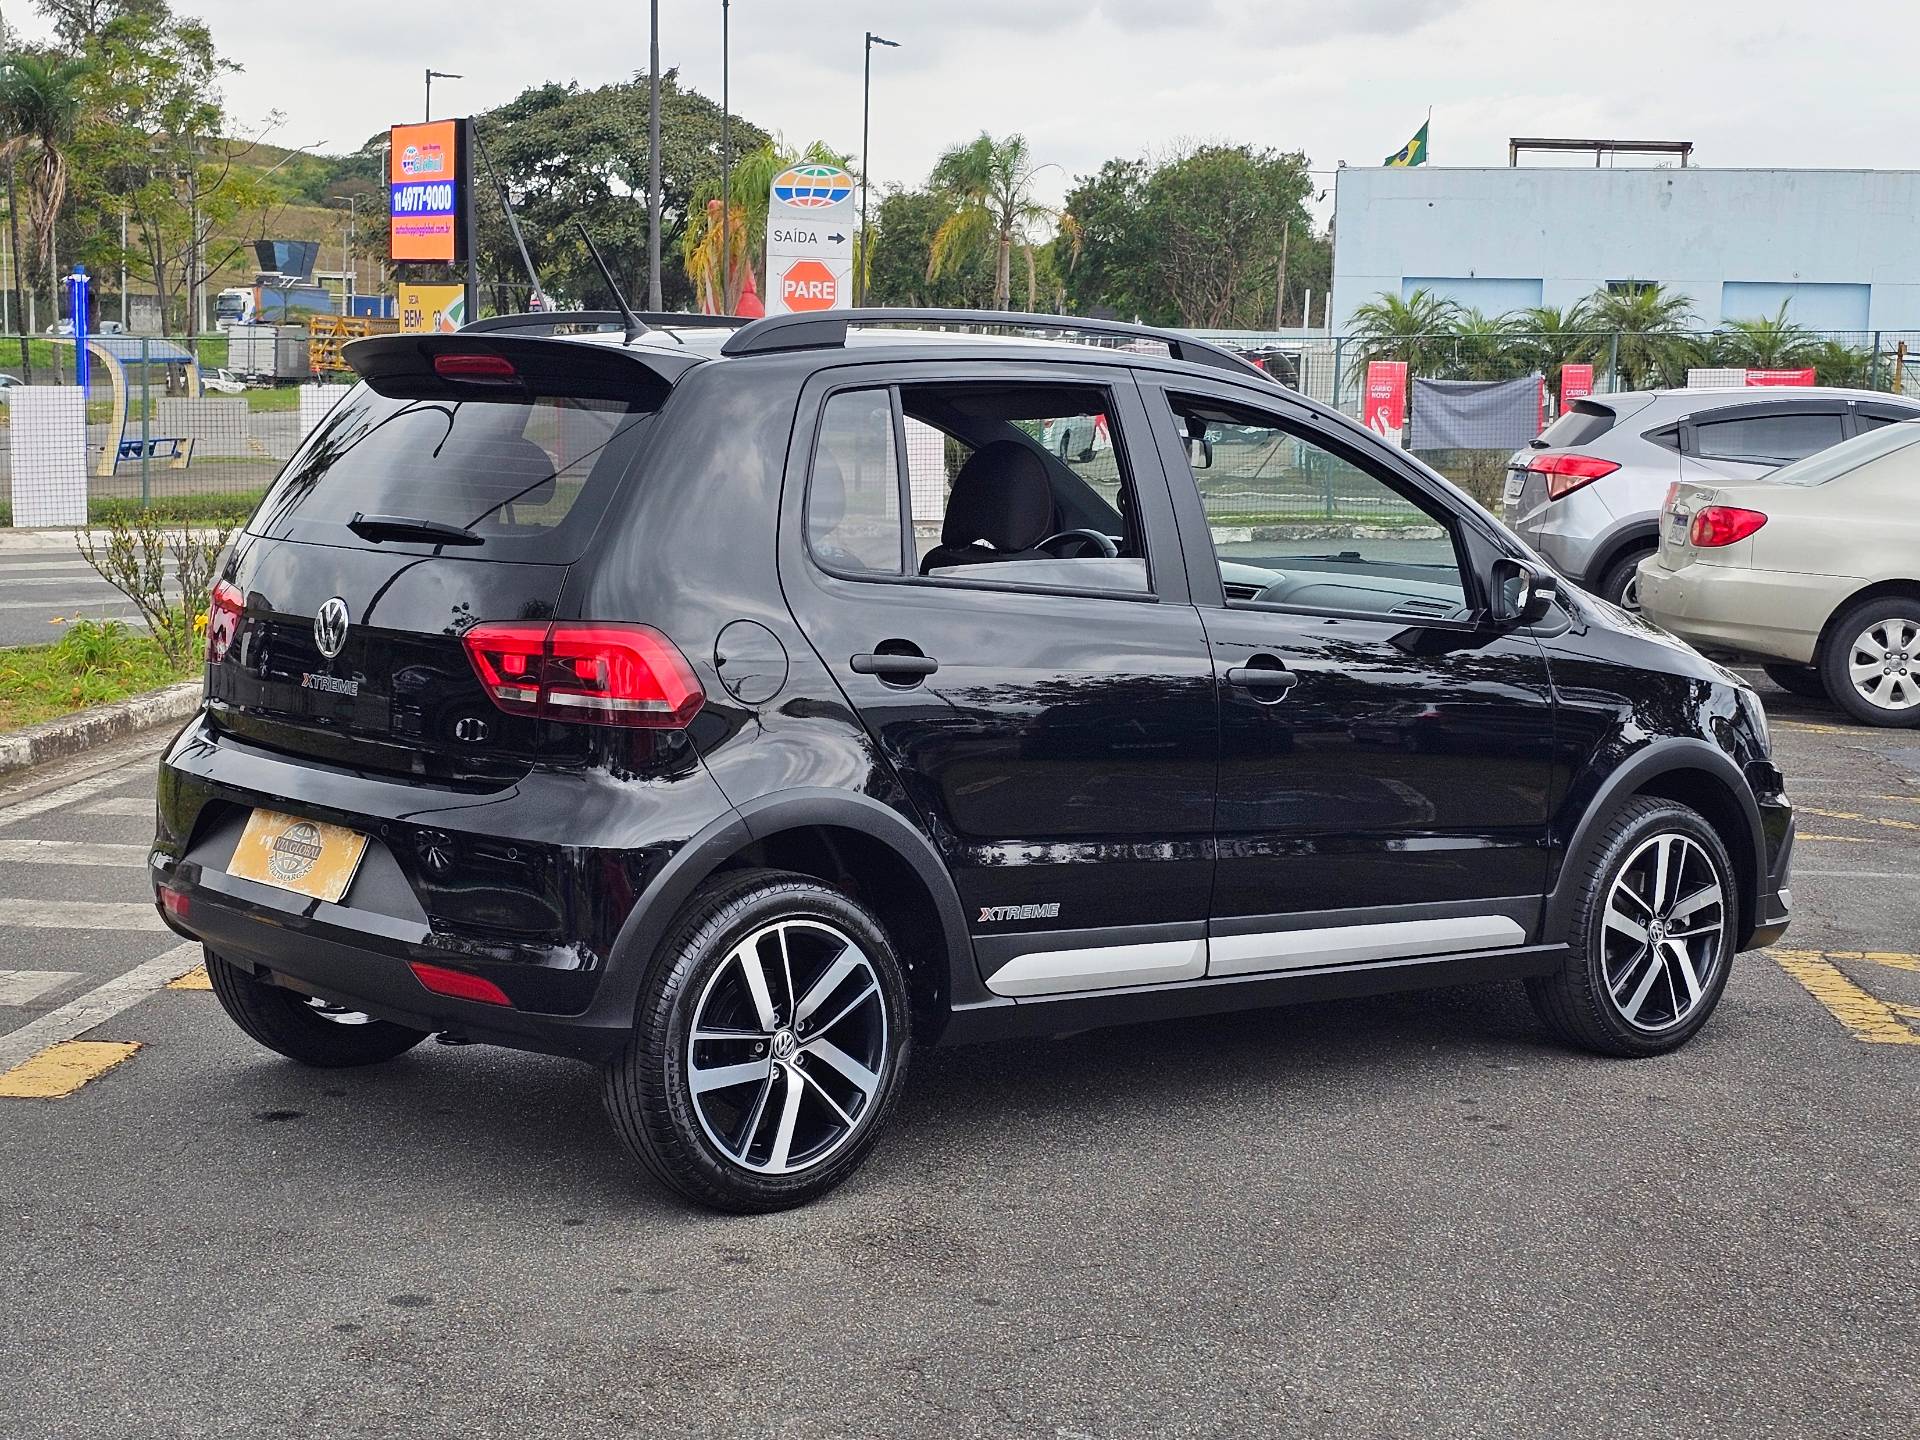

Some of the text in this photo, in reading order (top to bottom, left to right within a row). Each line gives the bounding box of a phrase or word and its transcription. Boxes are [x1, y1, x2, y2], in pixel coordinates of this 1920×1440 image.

[402, 186, 452, 211] 4977-9000
[774, 228, 818, 244] SAÍDA
[784, 280, 835, 300] PARE
[404, 309, 425, 328] BEM-
[301, 673, 359, 697] XTREME
[275, 838, 319, 859] VIA GLOBAL
[977, 902, 1061, 922] XTREME
